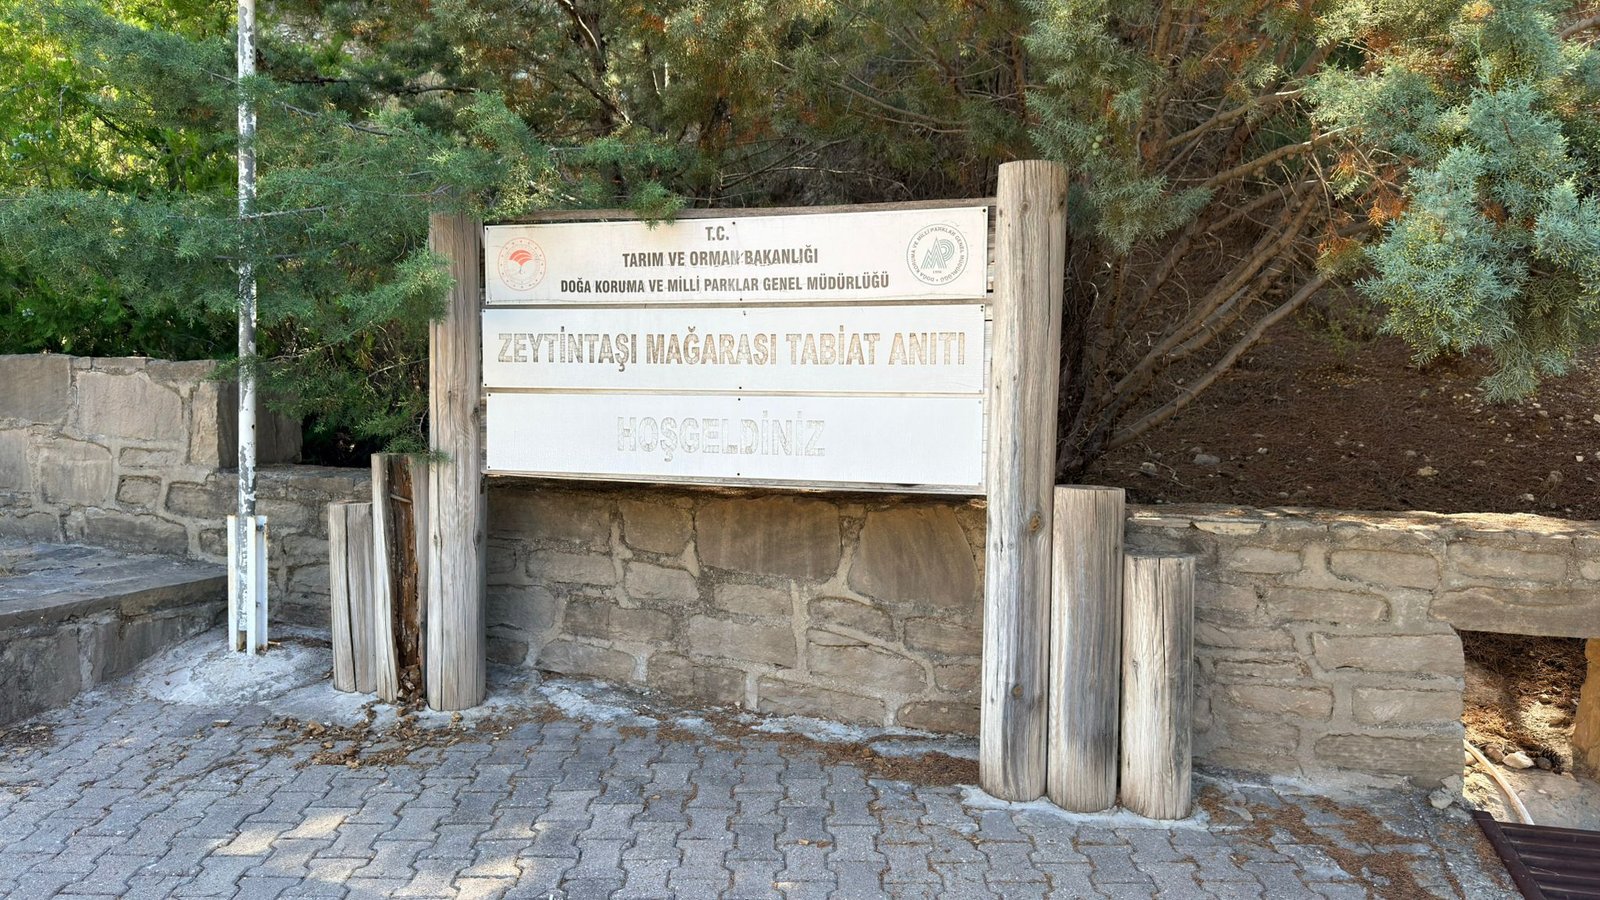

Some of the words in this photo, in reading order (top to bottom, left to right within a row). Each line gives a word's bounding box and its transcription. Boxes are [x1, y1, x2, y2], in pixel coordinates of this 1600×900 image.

[705, 226, 729, 241] T.C.
[622, 252, 664, 268] TARIM
[668, 251, 685, 267] VE
[689, 250, 740, 267] ORMAN
[744, 244, 819, 266] BAKANLIĞI
[560, 277, 592, 293] DOĞA
[595, 280, 645, 293] KORUMA
[649, 279, 664, 292] VE
[667, 275, 700, 292] MİLLİ
[704, 277, 759, 292] PARKLAR
[763, 276, 803, 291] GENEL
[807, 270, 889, 290] MÜDÜRLÜĞÜ
[497, 325, 637, 373] ZEYTİNTAŞI
[646, 325, 777, 365] MAĞARASI
[785, 325, 881, 365] TABİAT
[888, 332, 966, 365] ANITI
[617, 410, 826, 462] HOŞGELDİNİZ
